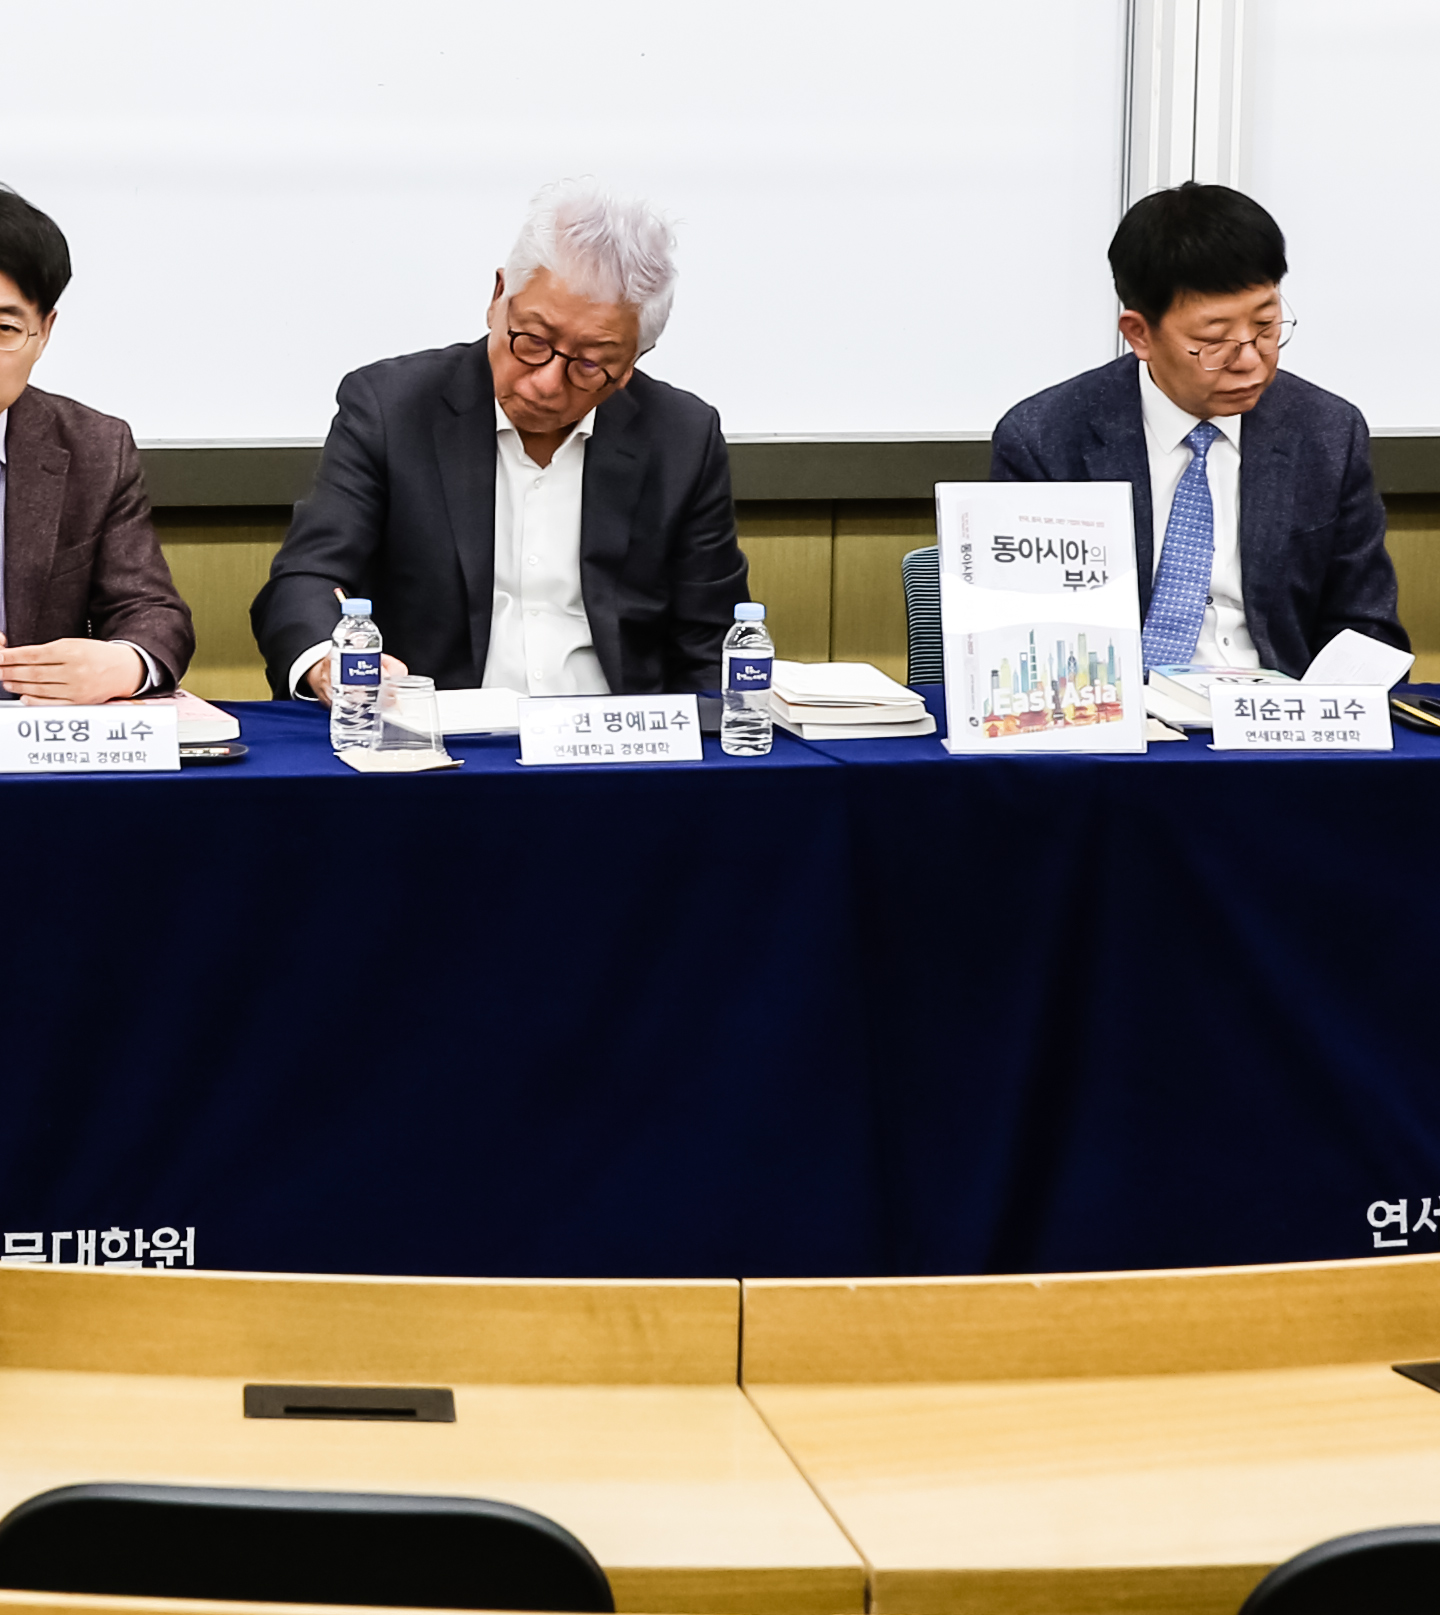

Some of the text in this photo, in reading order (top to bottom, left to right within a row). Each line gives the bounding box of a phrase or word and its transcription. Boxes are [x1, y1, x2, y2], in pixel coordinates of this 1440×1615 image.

[991, 535, 1107, 566] 동아시아의
[993, 679, 1117, 716] East Asia
[1234, 698, 1366, 721] 최순규 교수
[17, 719, 154, 743] 이호영 교수
[603, 710, 691, 733] 명예교수
